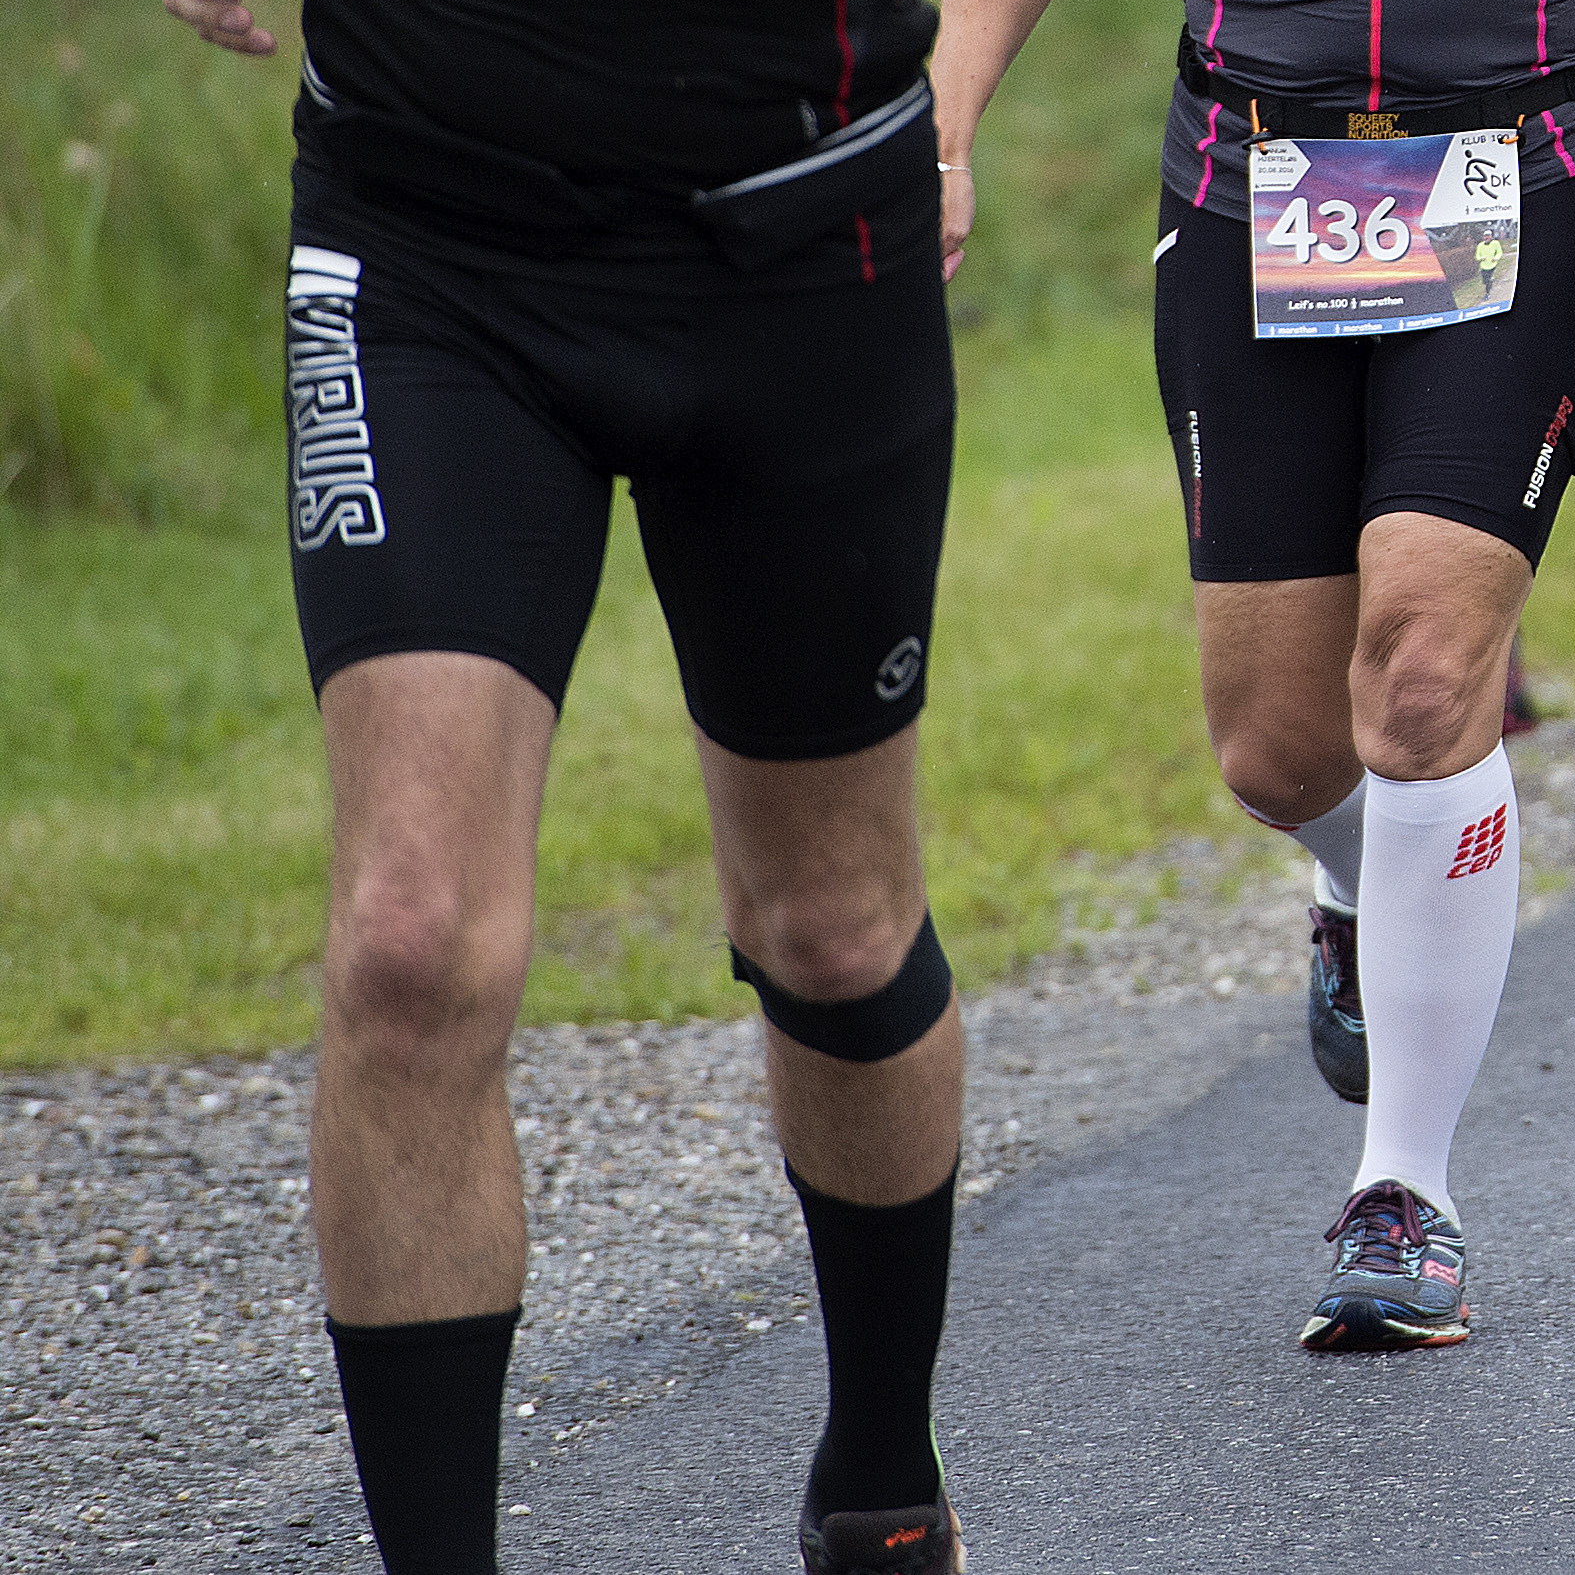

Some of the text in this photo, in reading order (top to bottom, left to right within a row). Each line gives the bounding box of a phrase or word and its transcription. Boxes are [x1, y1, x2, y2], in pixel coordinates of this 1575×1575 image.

[1348, 113, 1400, 124] SQUEEZY
[1348, 123, 1393, 132] SPORTS
[1461, 134, 1487, 146] KLUB
[1490, 174, 1513, 188] DK
[1474, 203, 1513, 213] marathon
[1267, 196, 1411, 263] 436
[1360, 296, 1403, 307] marathon
[1447, 843, 1504, 880] cep
